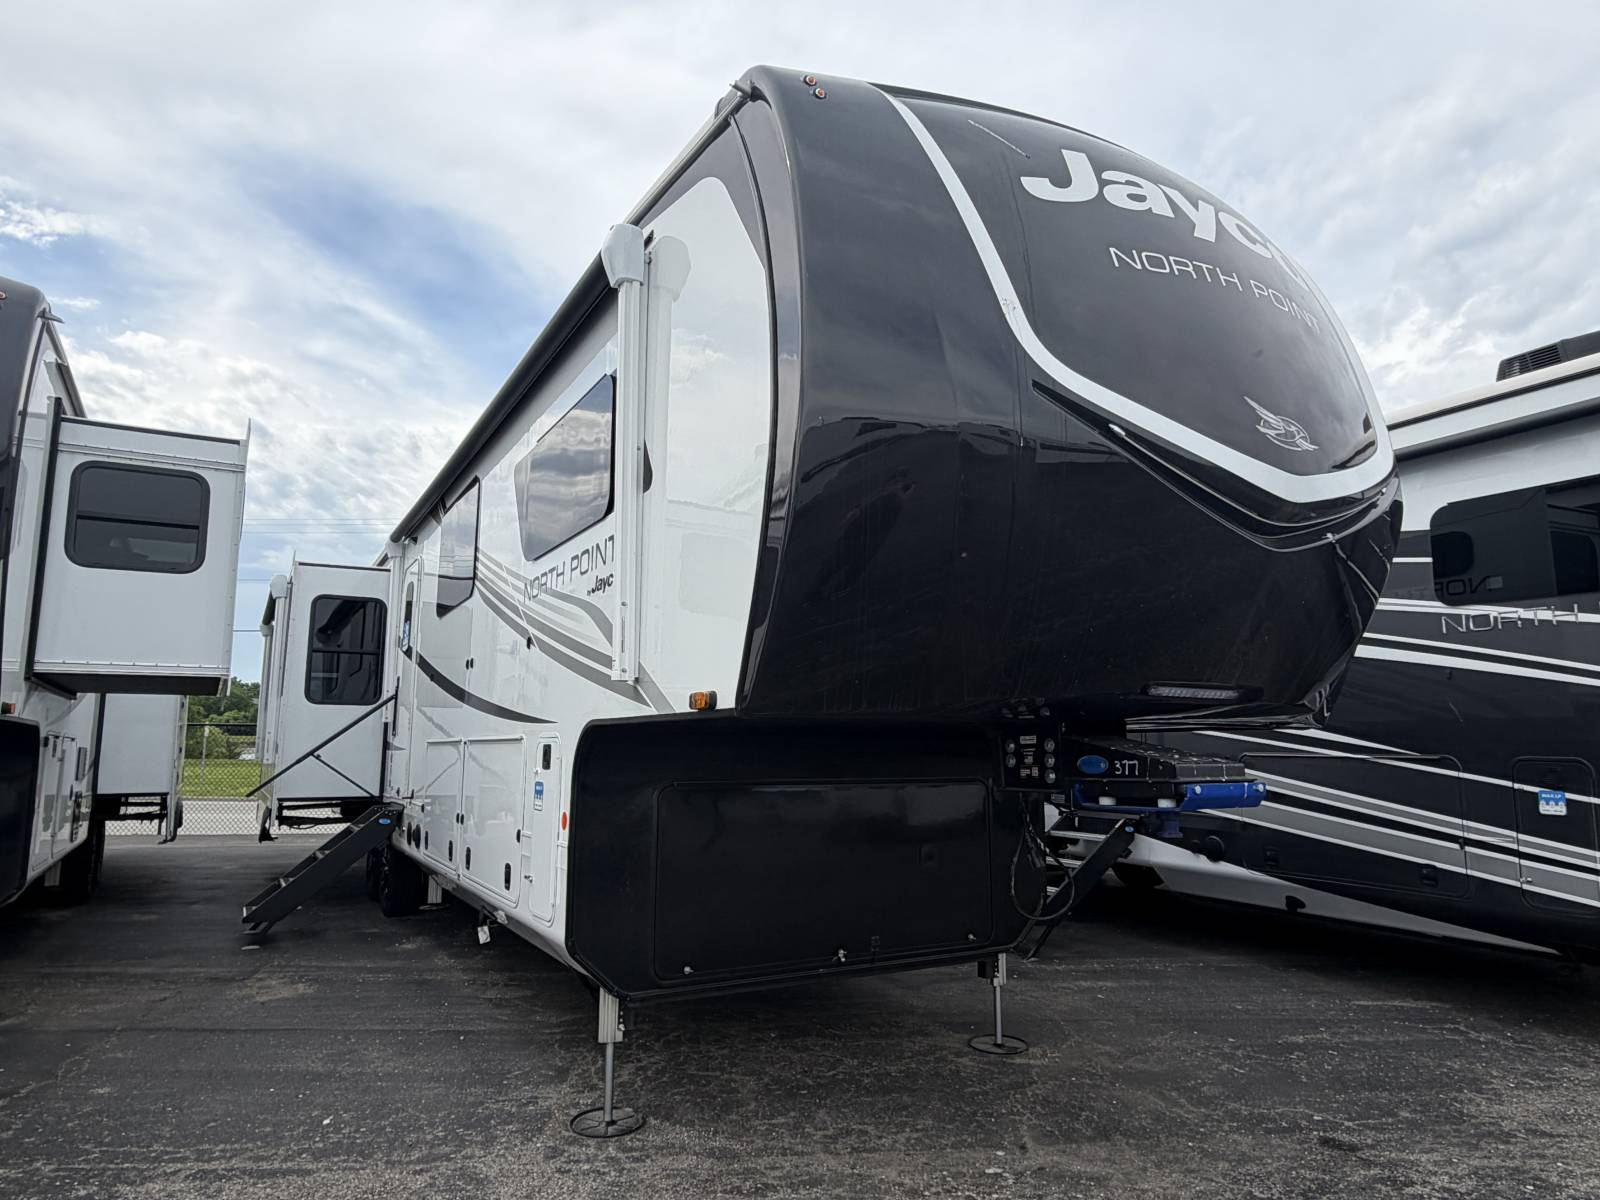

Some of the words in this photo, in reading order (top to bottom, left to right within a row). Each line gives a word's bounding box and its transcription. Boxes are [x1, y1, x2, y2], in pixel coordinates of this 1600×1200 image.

[1109, 247, 1243, 291] NORTH
[1249, 279, 1320, 334] POINT
[524, 561, 566, 603] NORTH
[570, 534, 614, 582] POINT
[1441, 603, 1579, 634] NORTH
[1114, 759, 1139, 776] 377
